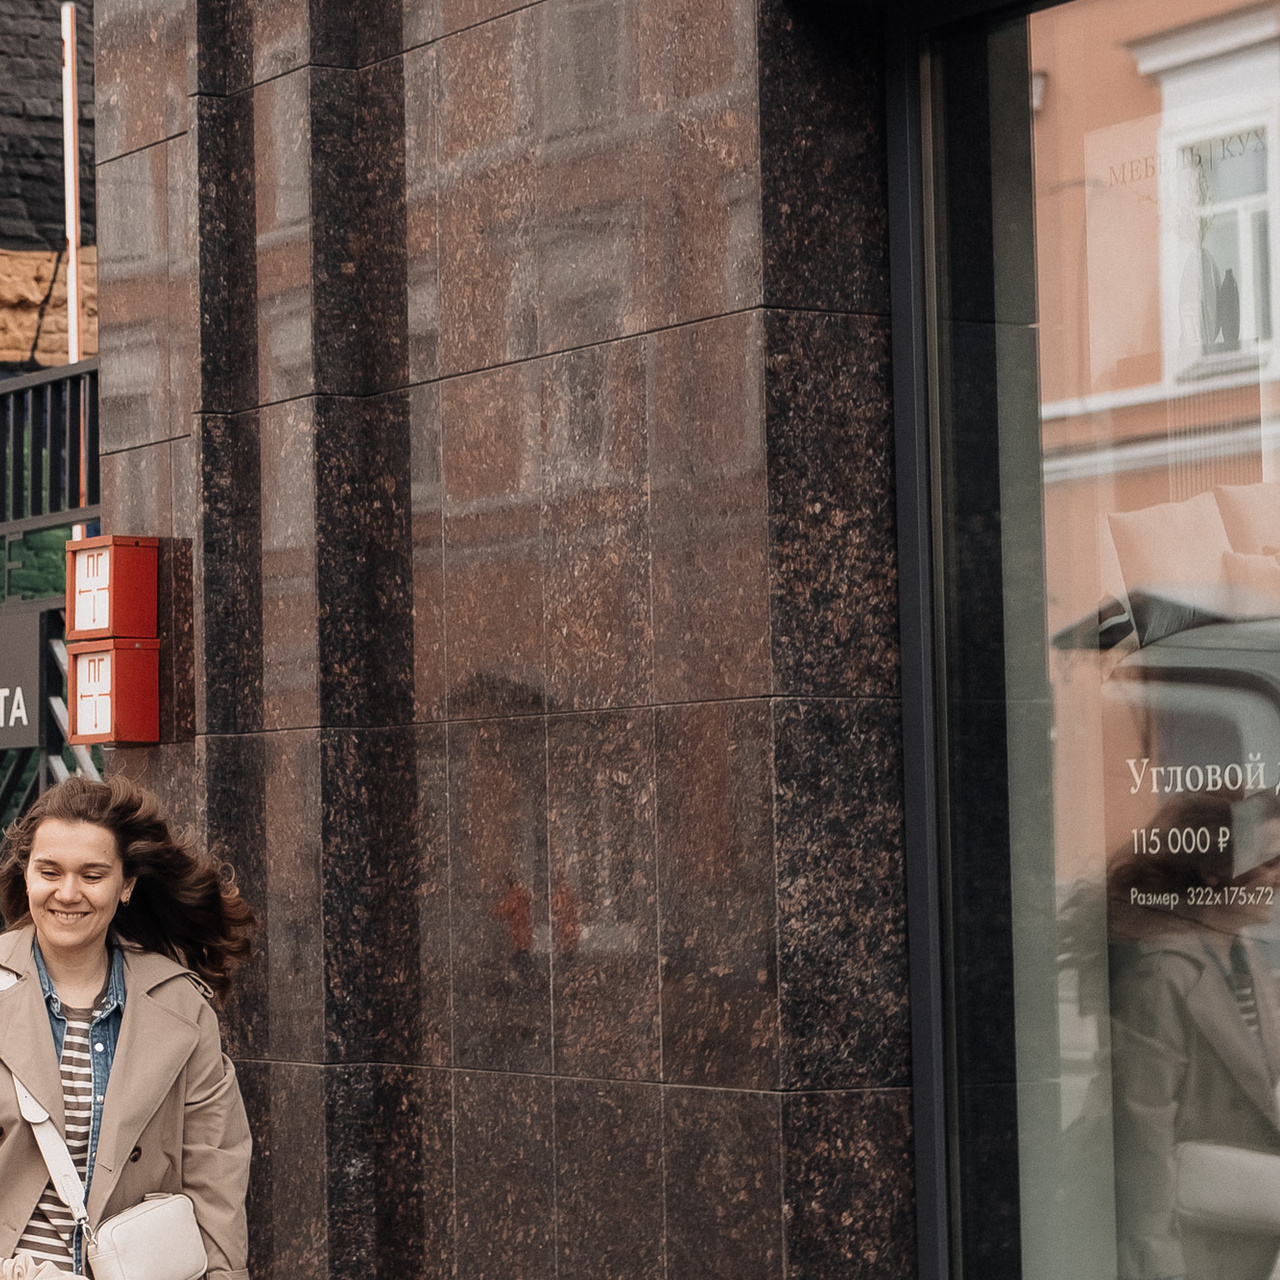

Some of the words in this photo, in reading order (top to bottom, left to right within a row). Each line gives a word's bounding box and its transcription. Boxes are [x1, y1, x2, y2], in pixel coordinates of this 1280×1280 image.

[86, 552, 104, 579] ПГ
[88, 657, 105, 684] ПГ
[1126, 752, 1266, 794] Угловой
[1132, 827, 1161, 855] 115
[1167, 826, 1212, 854] 000
[1130, 887, 1180, 910] Размер
